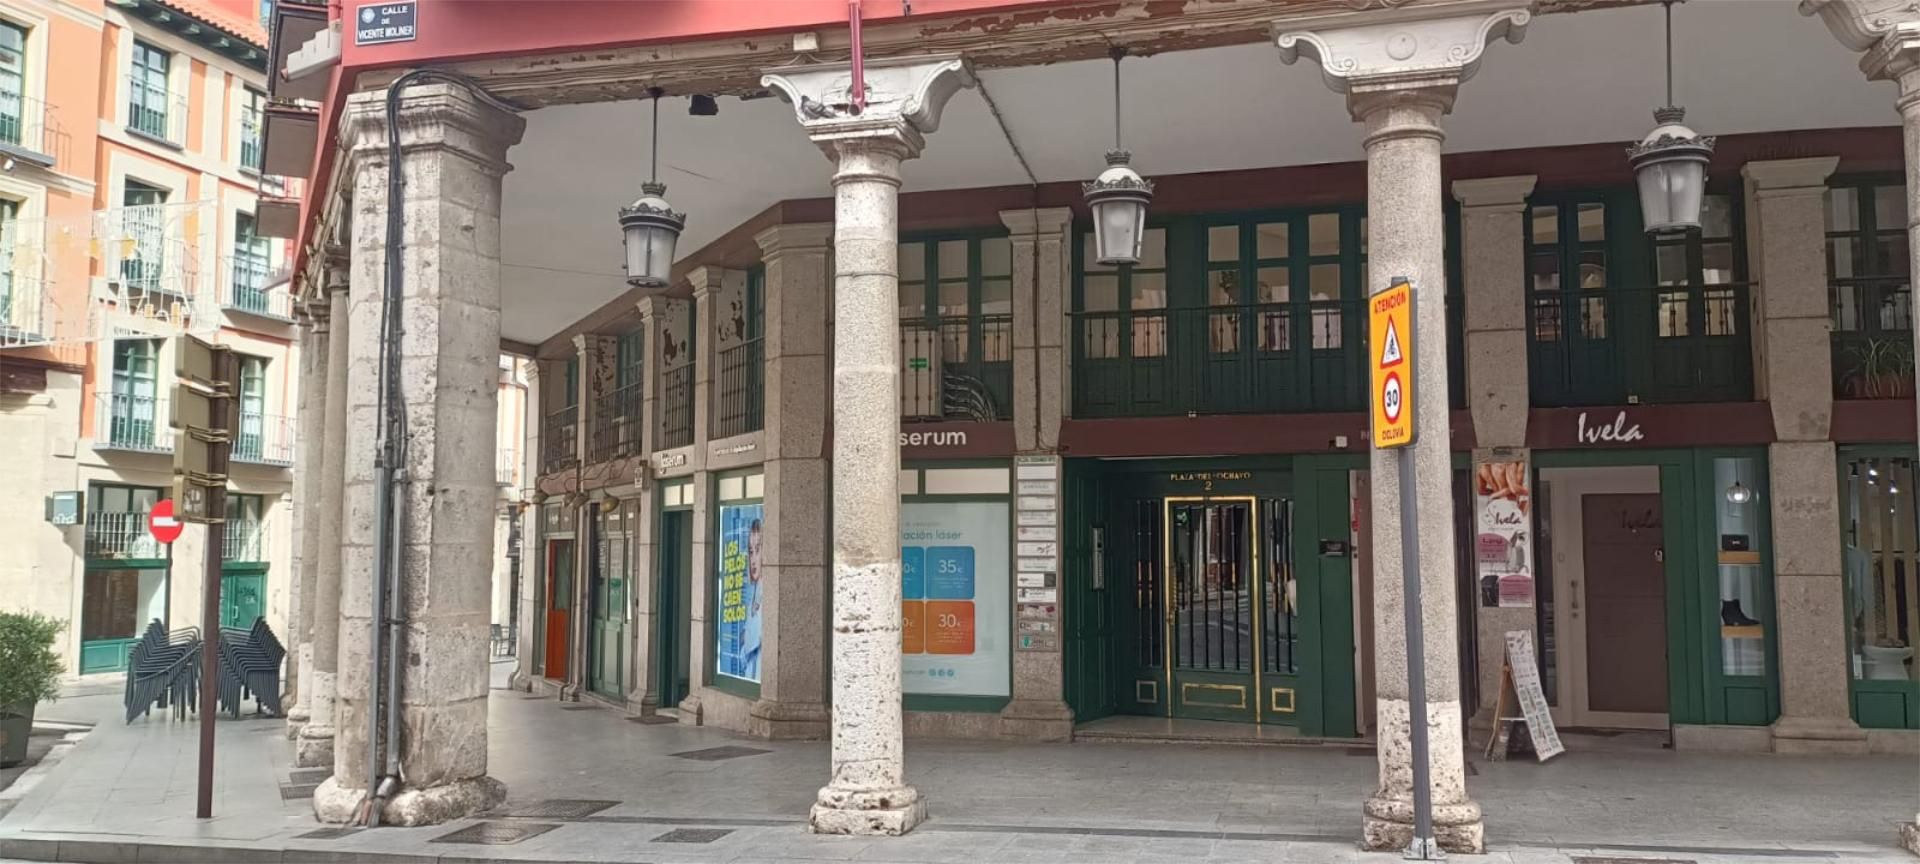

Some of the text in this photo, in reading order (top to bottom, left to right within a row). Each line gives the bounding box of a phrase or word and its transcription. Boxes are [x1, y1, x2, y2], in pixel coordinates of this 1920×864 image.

[382, 6, 408, 15] CALLE
[358, 26, 413, 39] VICENTE MOLINER
[1386, 389, 1398, 407] 30
[1579, 411, 1644, 443] Ivela
[898, 431, 967, 446] serum
[1205, 481, 1212, 490] 2
[902, 528, 933, 540] ación
[725, 541, 738, 557] LOS
[725, 554, 746, 574] PELOS
[724, 574, 734, 591] NO
[724, 591, 741, 607] CAEN
[723, 606, 746, 623] SOLOS
